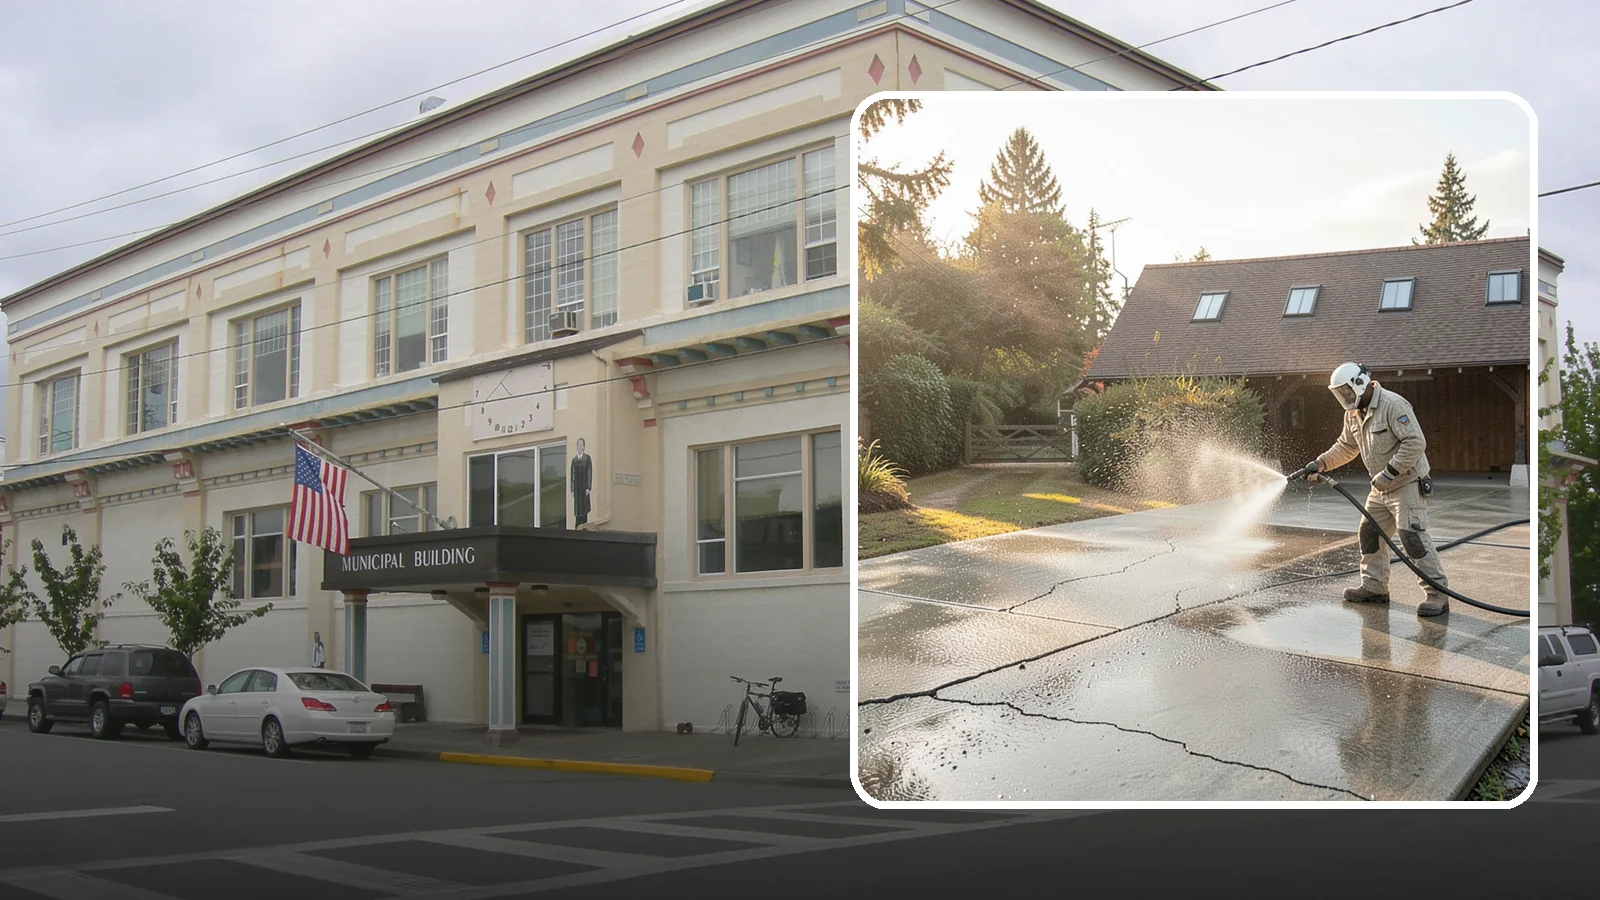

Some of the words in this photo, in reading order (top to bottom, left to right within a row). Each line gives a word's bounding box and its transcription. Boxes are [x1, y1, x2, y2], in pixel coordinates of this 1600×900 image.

[536, 402, 540, 410] 4
[487, 417, 493, 426] 9
[528, 414, 533, 422] 3
[520, 420, 526, 428] 2
[342, 552, 405, 571] MUNICIPAL
[414, 546, 475, 567] BUILDING
